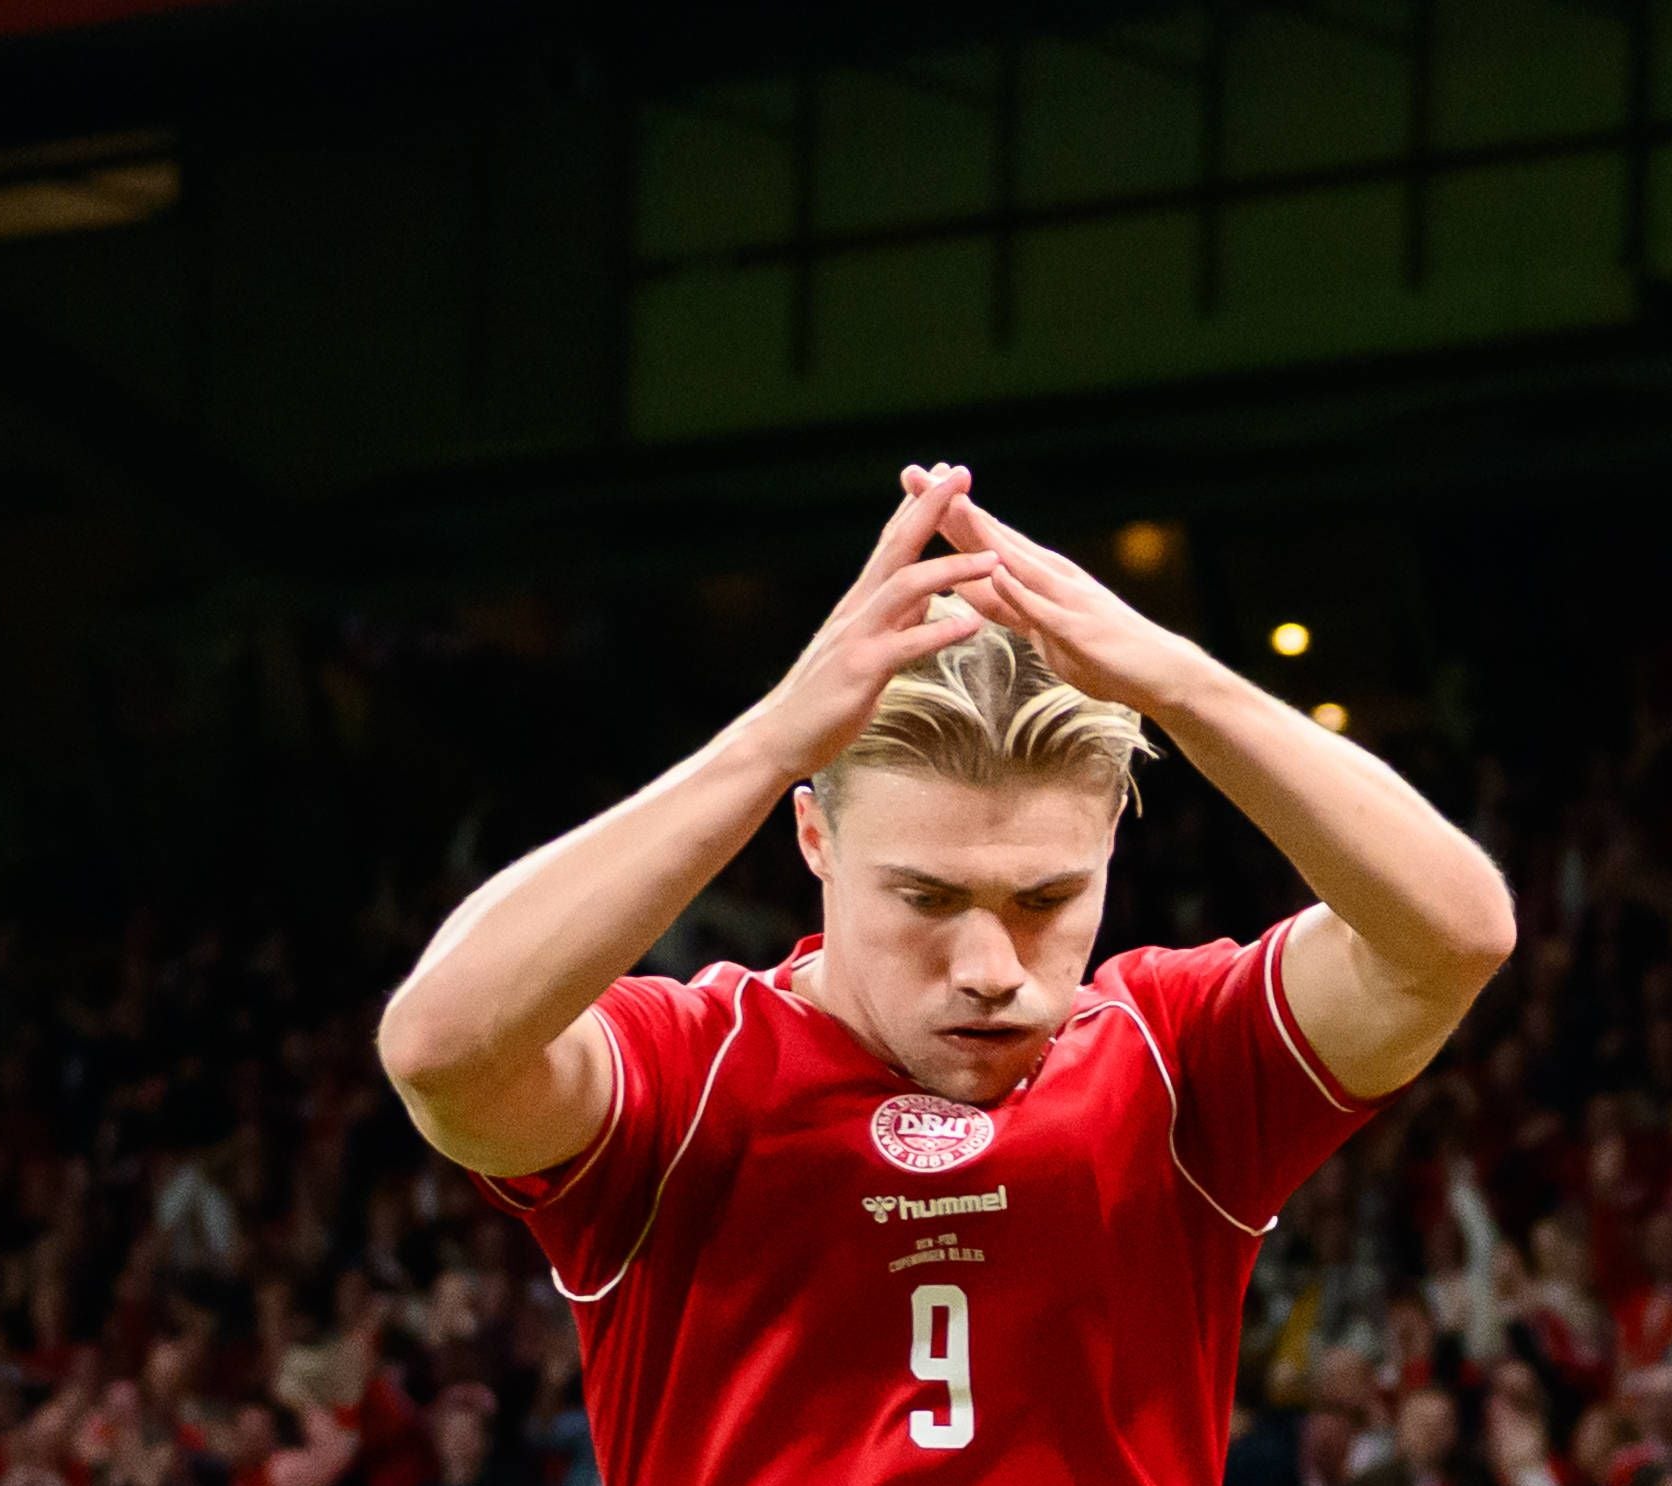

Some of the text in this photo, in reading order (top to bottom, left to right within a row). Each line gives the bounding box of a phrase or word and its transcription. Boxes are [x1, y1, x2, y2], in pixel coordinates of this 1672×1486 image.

[897, 1112, 969, 1139] DBU
[906, 1152, 957, 1168] 1889
[899, 1185, 1008, 1220] hummel
[909, 1284, 975, 1451] 9
